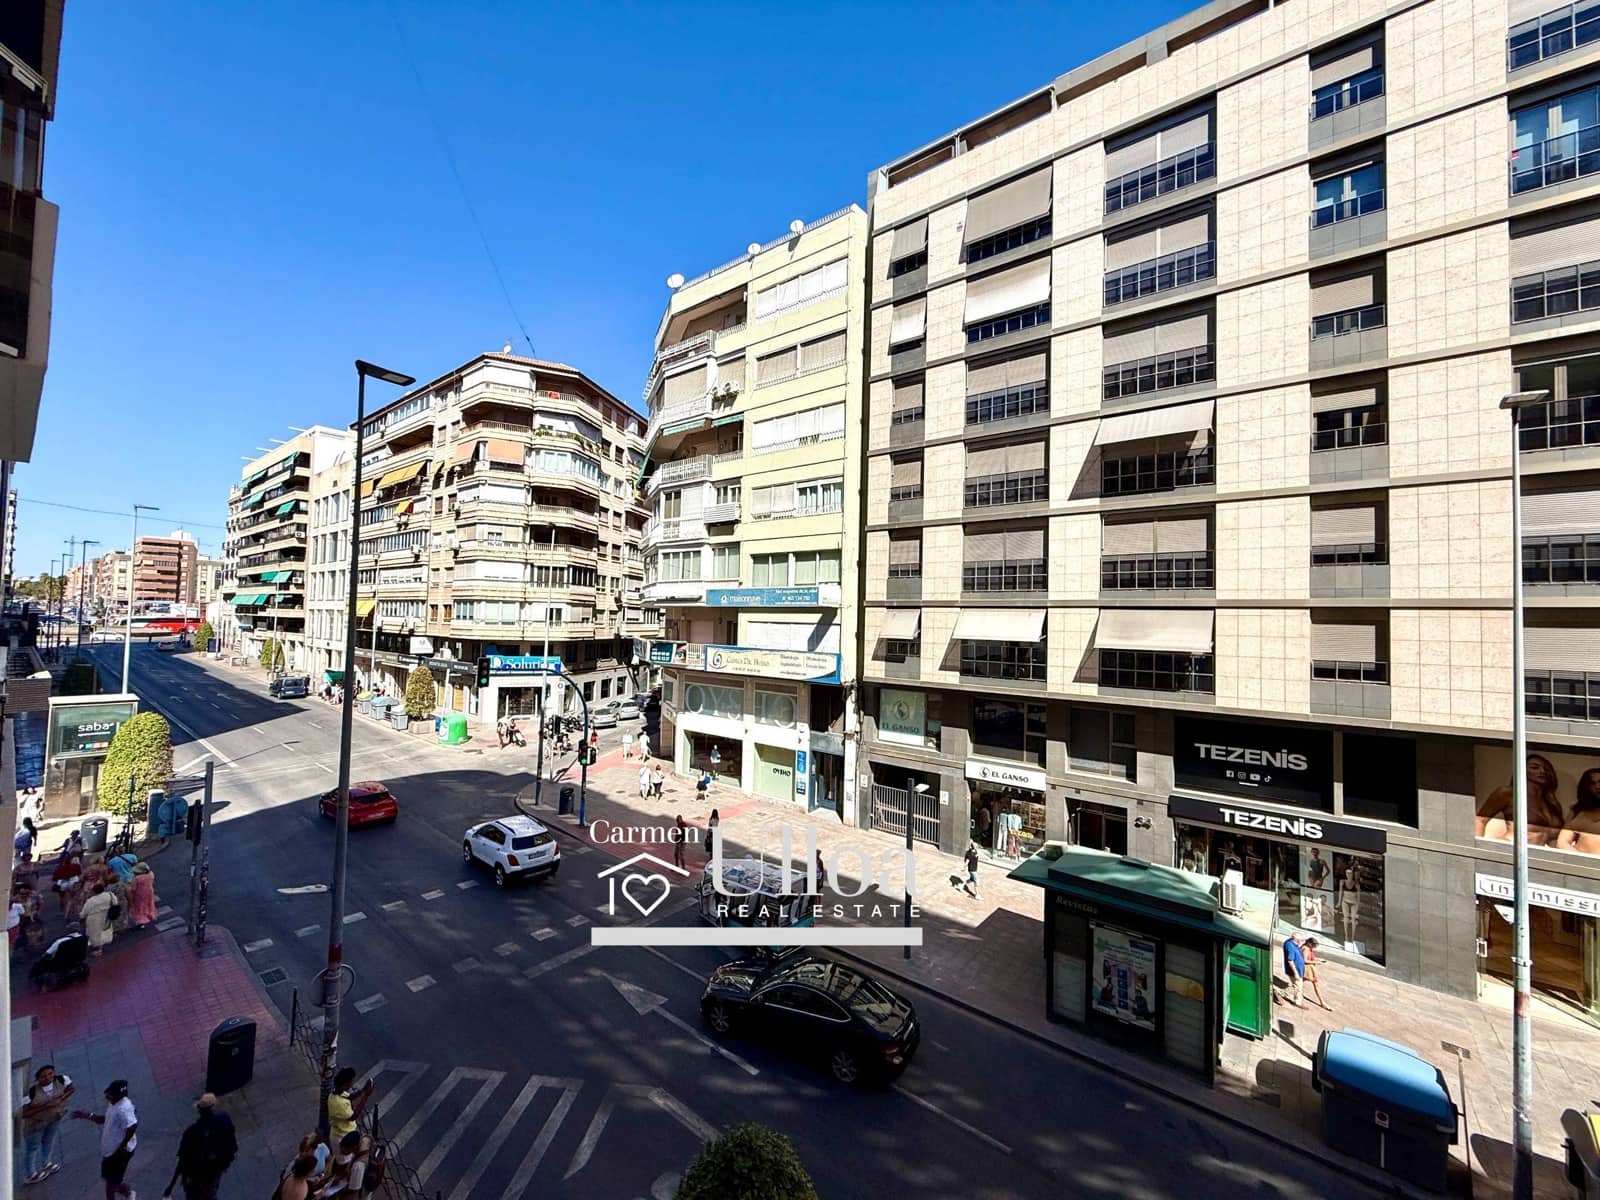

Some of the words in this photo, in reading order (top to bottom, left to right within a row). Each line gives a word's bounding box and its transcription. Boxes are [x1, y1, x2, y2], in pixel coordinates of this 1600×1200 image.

[78, 722, 110, 732] saba
[893, 723, 920, 734] GANSO
[1001, 773, 1029, 784] GANSO
[1056, 895, 1098, 914] Revistas
